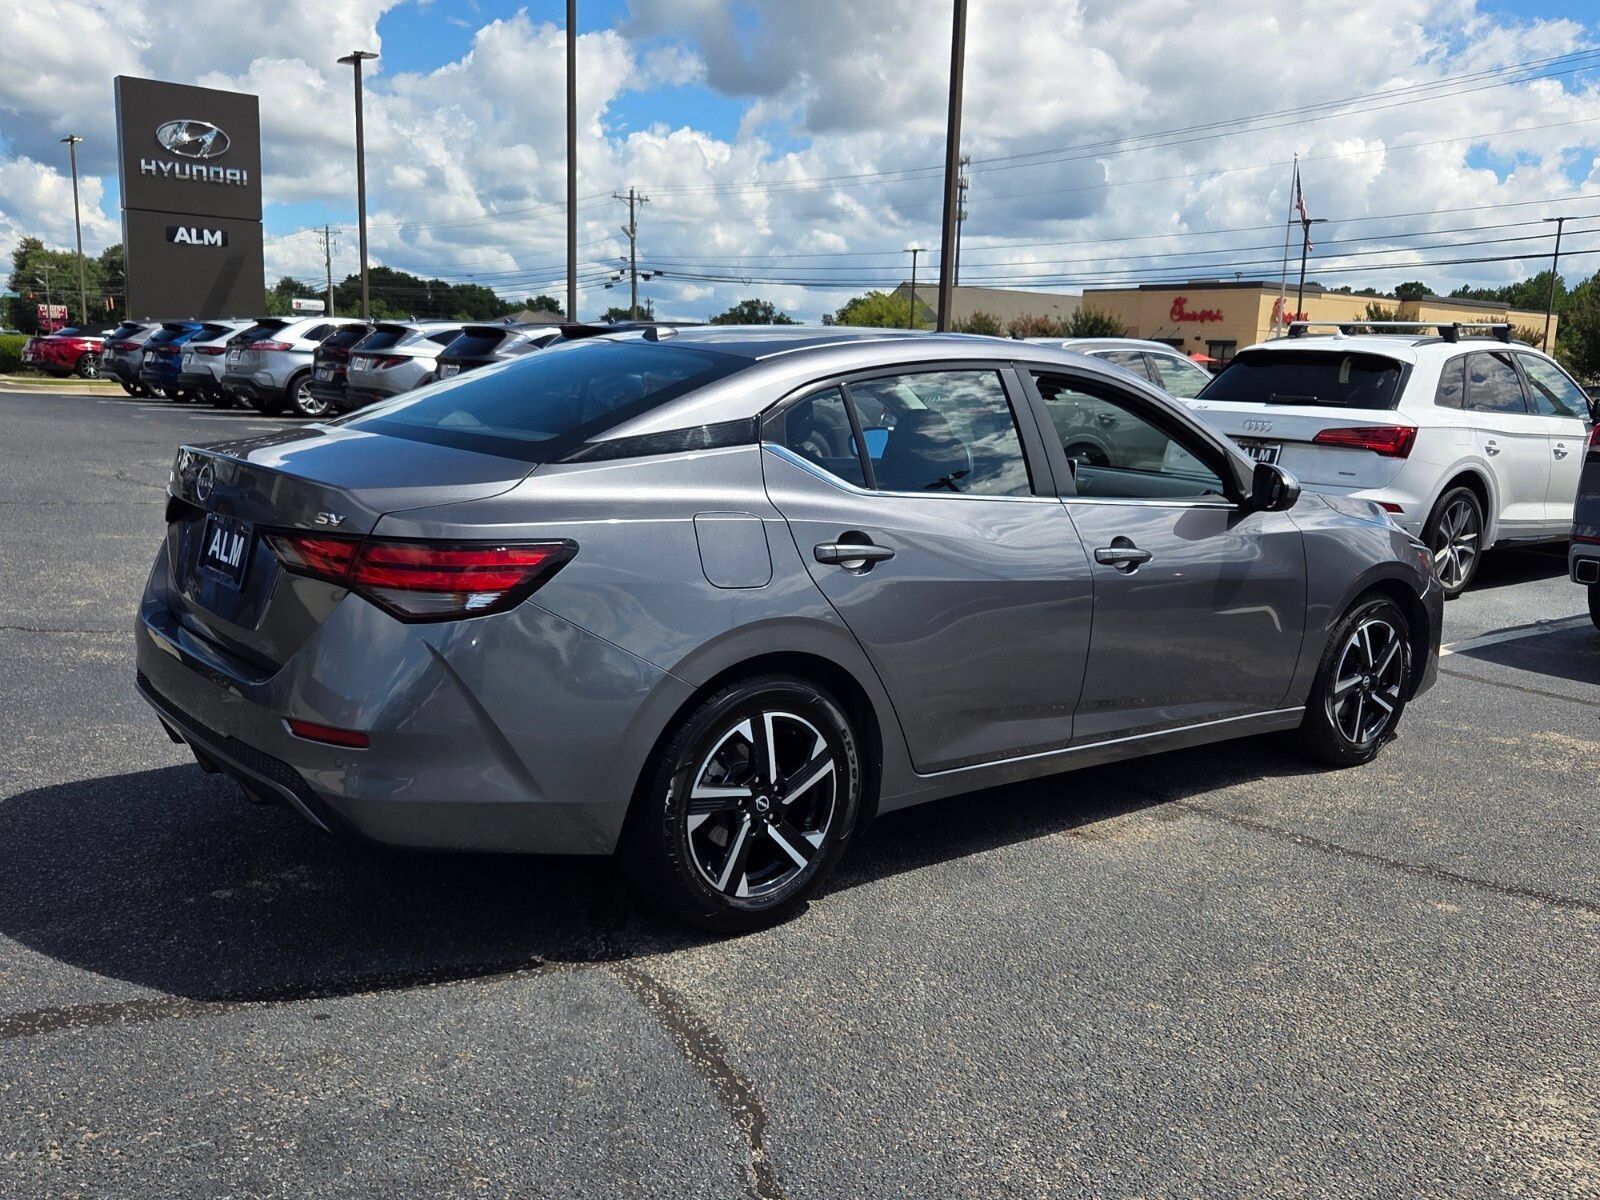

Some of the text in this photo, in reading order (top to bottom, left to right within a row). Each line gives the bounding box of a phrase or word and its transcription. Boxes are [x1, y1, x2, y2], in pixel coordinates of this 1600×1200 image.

[140, 158, 248, 186] HYUNDAI
[173, 226, 222, 247] ALM
[315, 512, 345, 527] SV
[208, 528, 244, 568] ALM
